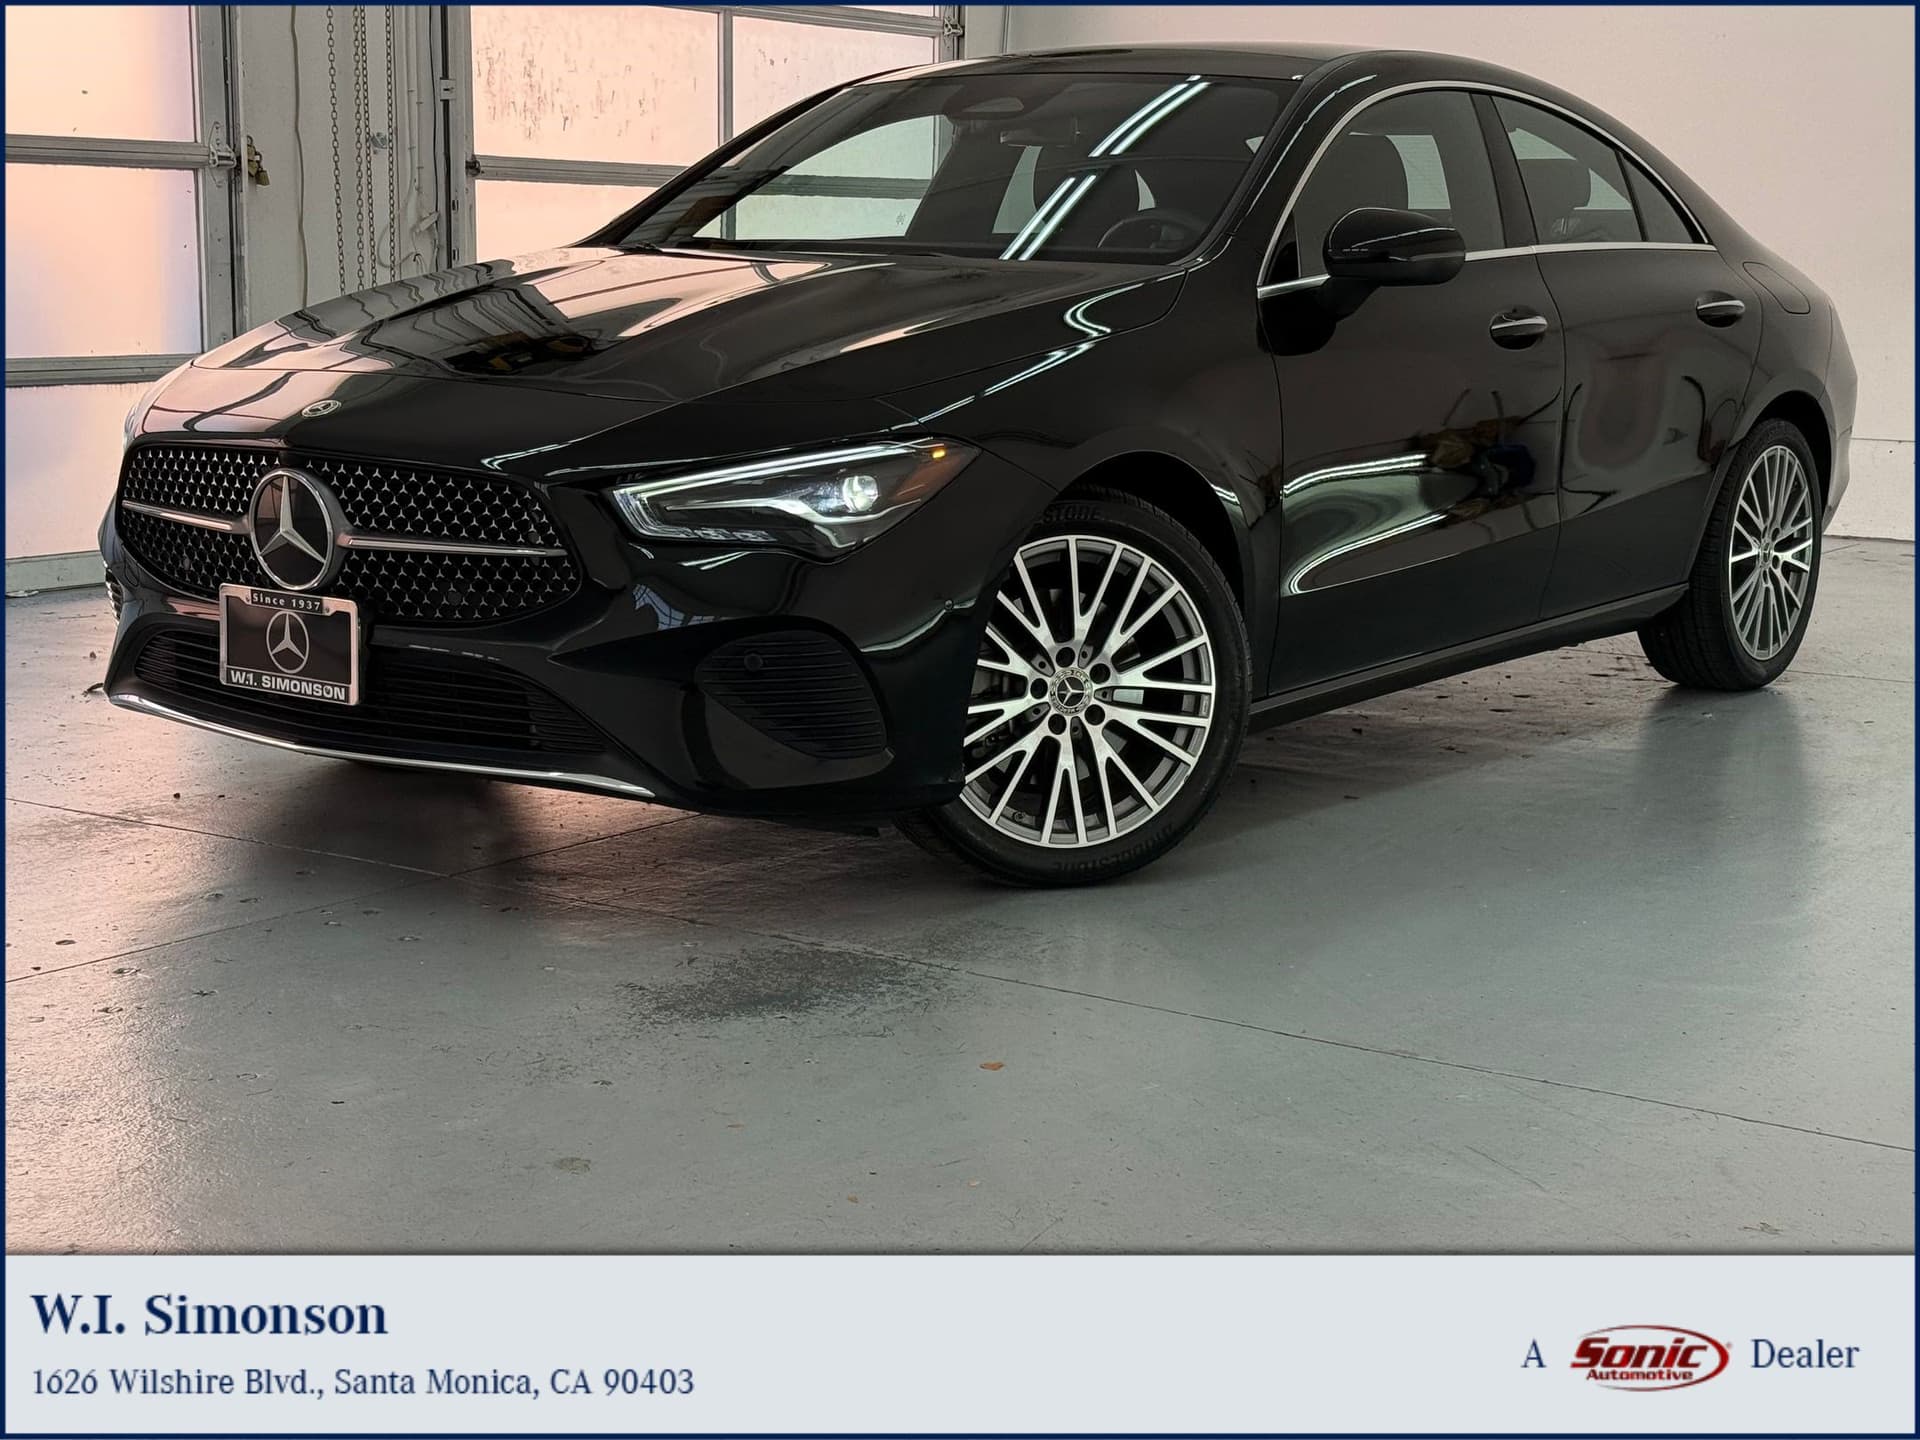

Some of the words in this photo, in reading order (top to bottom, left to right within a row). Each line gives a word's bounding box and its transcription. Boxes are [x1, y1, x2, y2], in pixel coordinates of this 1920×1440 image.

[252, 593, 285, 606] Since
[292, 596, 321, 610] 1937
[230, 670, 257, 686] W.I.
[261, 675, 346, 700] SIMONSON
